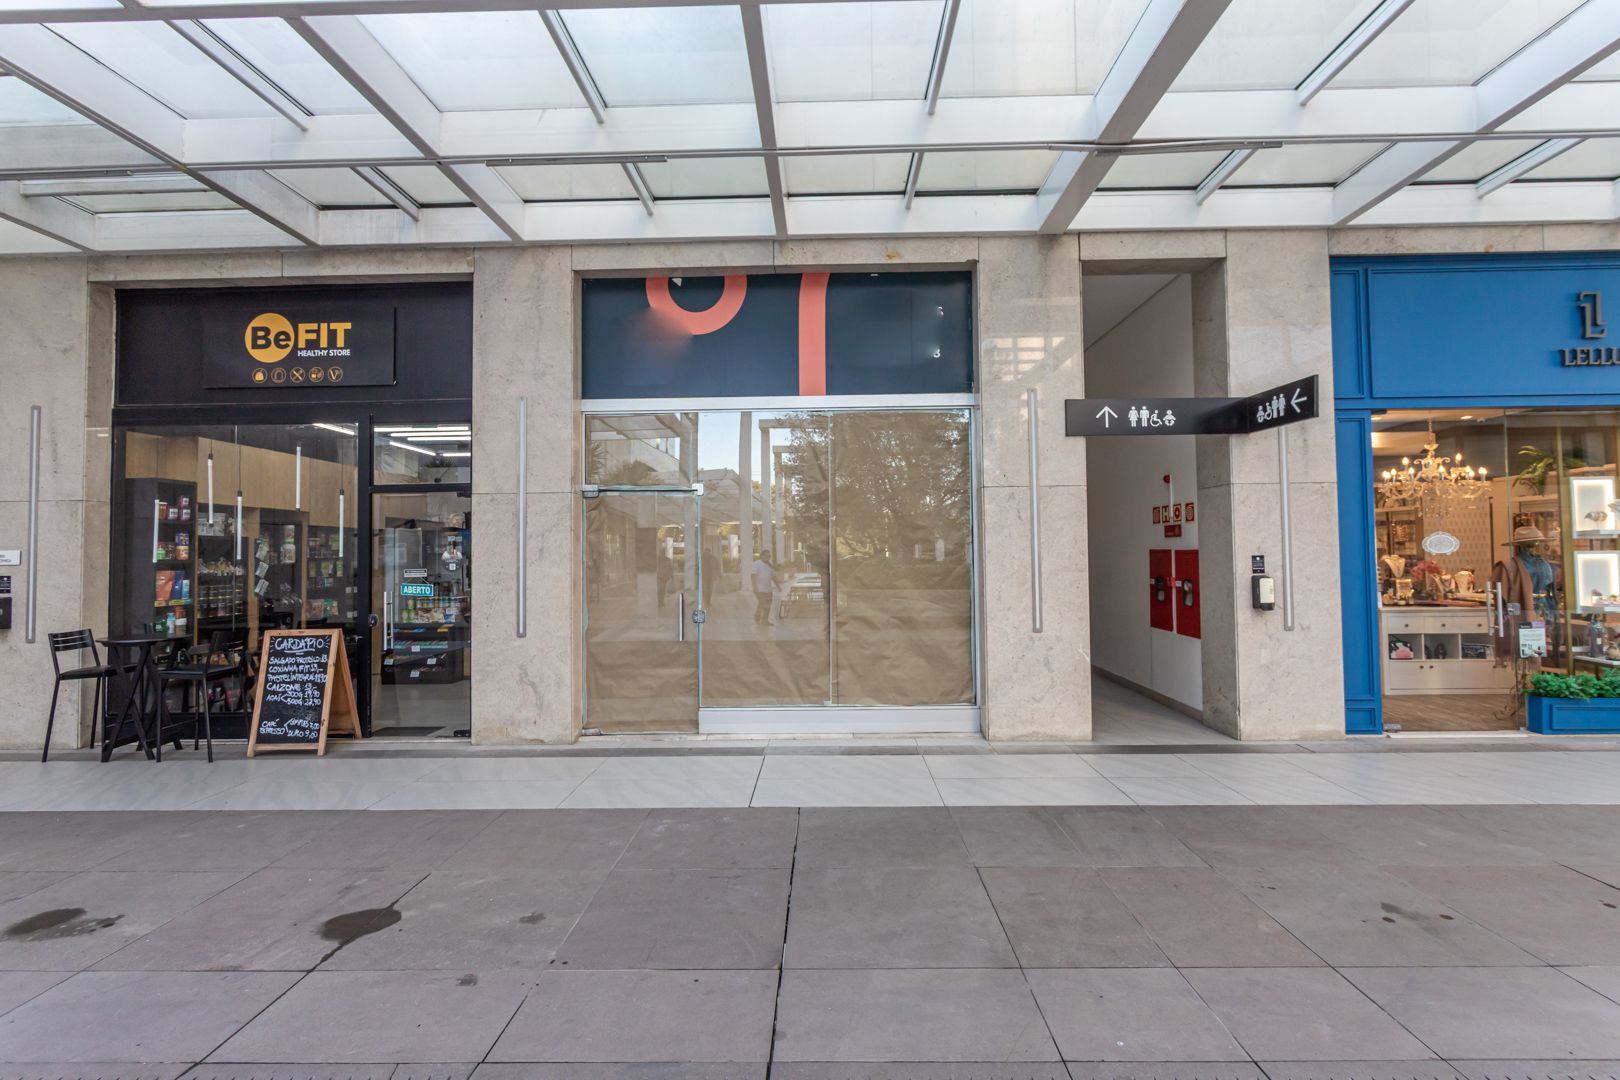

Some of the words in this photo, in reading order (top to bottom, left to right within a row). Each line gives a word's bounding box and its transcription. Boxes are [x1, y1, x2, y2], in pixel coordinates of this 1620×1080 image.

[403, 586, 431, 594] ABERTO
[269, 656, 295, 664] SALGADO
[268, 665, 298, 673] COXINHA
[266, 682, 301, 692] CALZONE
